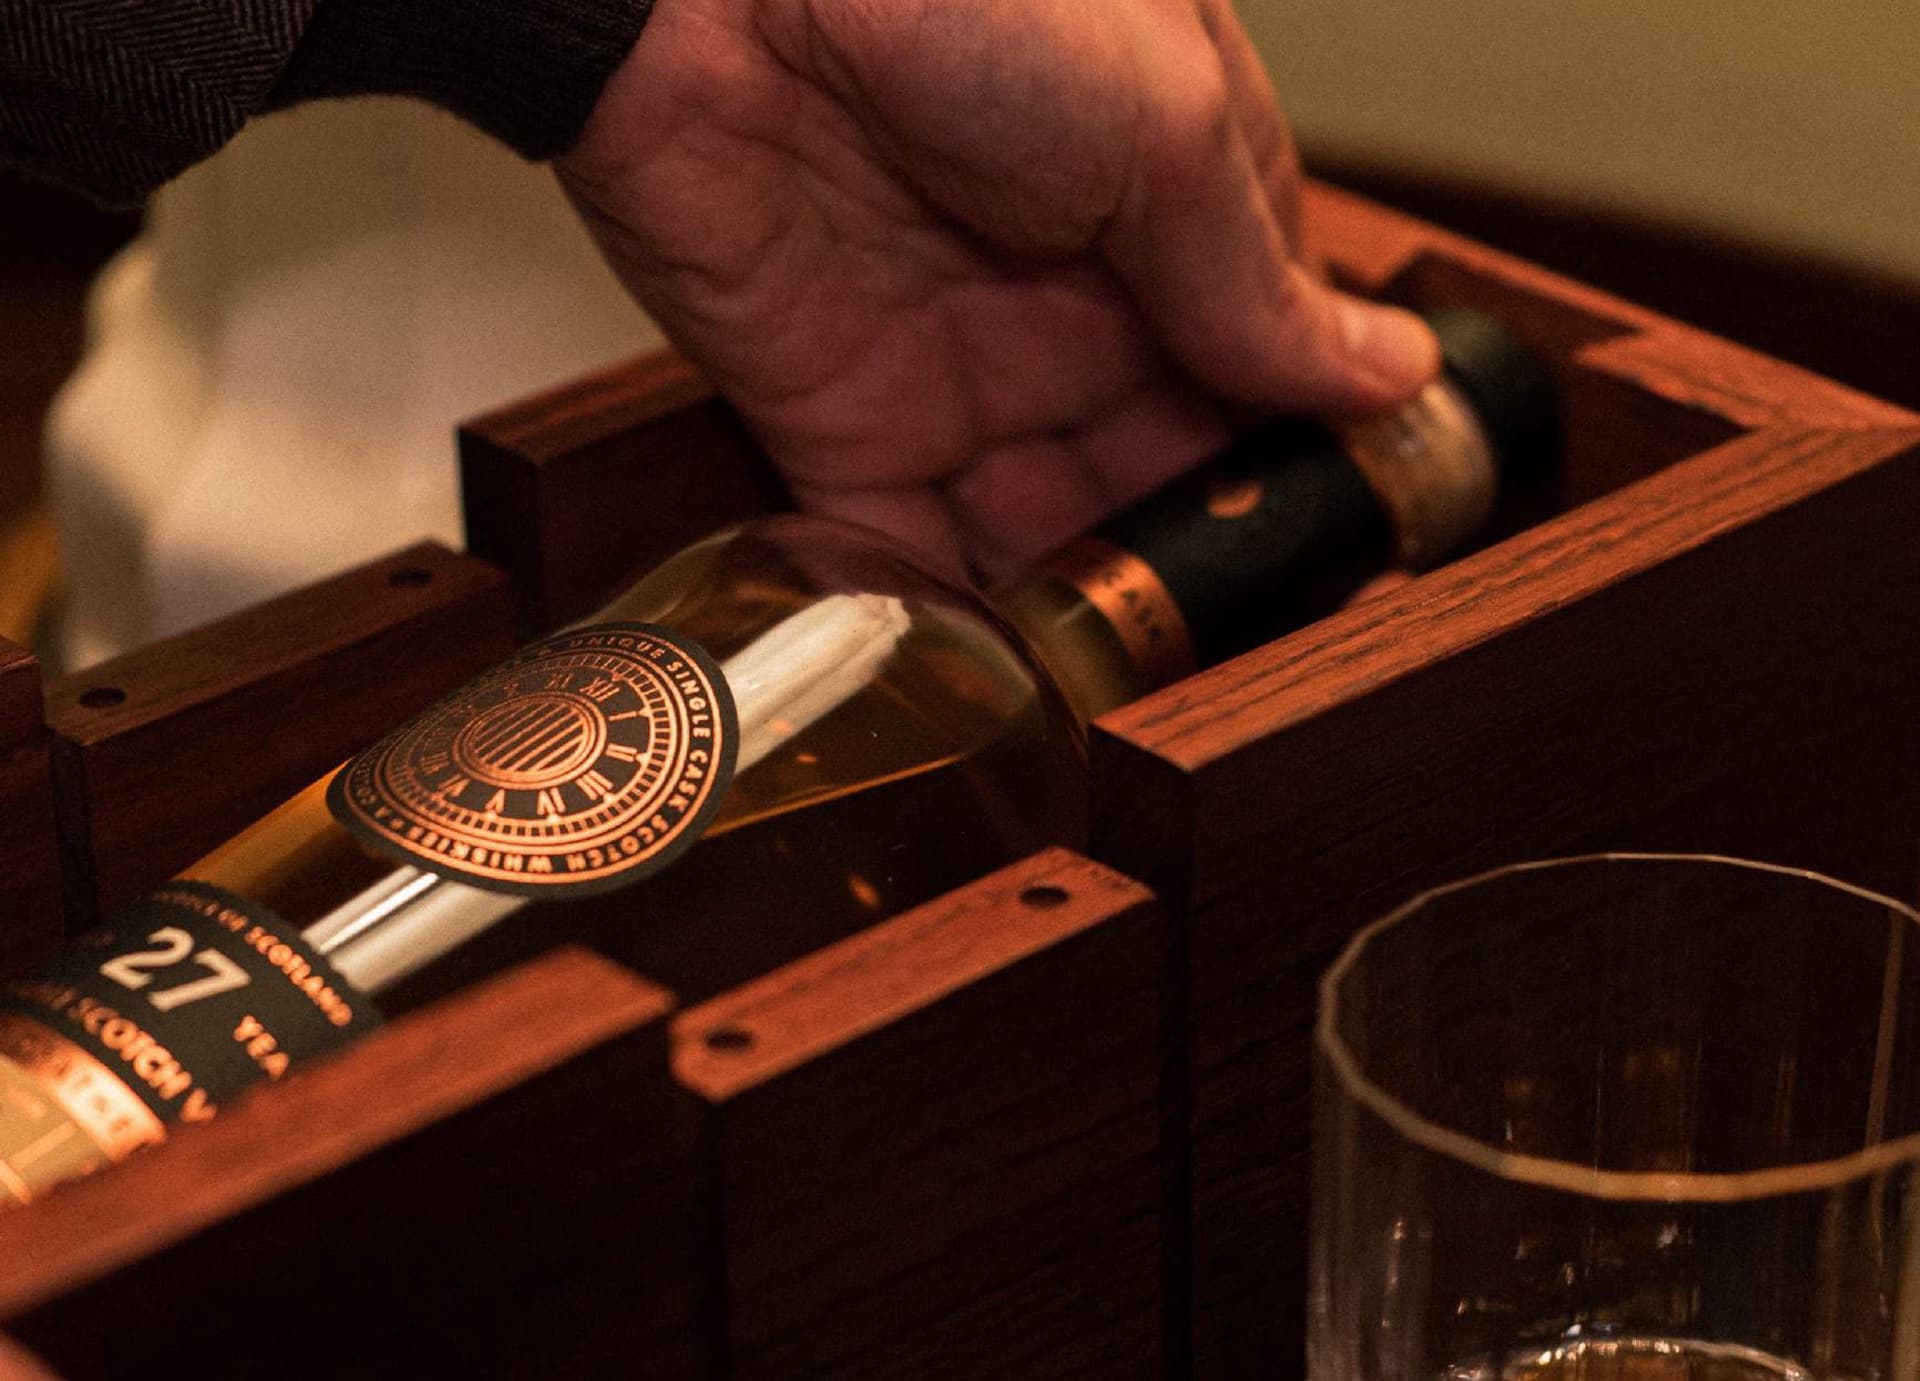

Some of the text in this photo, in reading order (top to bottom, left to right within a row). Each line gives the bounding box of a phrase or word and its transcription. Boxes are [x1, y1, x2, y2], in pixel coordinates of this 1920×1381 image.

[570, 636, 666, 659] UNIQUE
[666, 661, 711, 738] SINGLE
[666, 749, 709, 813] CASK
[407, 825, 553, 873] WHISKIES
[567, 814, 669, 873] SCOTCH
[100, 925, 252, 1013] 27
[244, 926, 353, 1027] SCOTLAND
[67, 998, 192, 1100] SCOTCH
